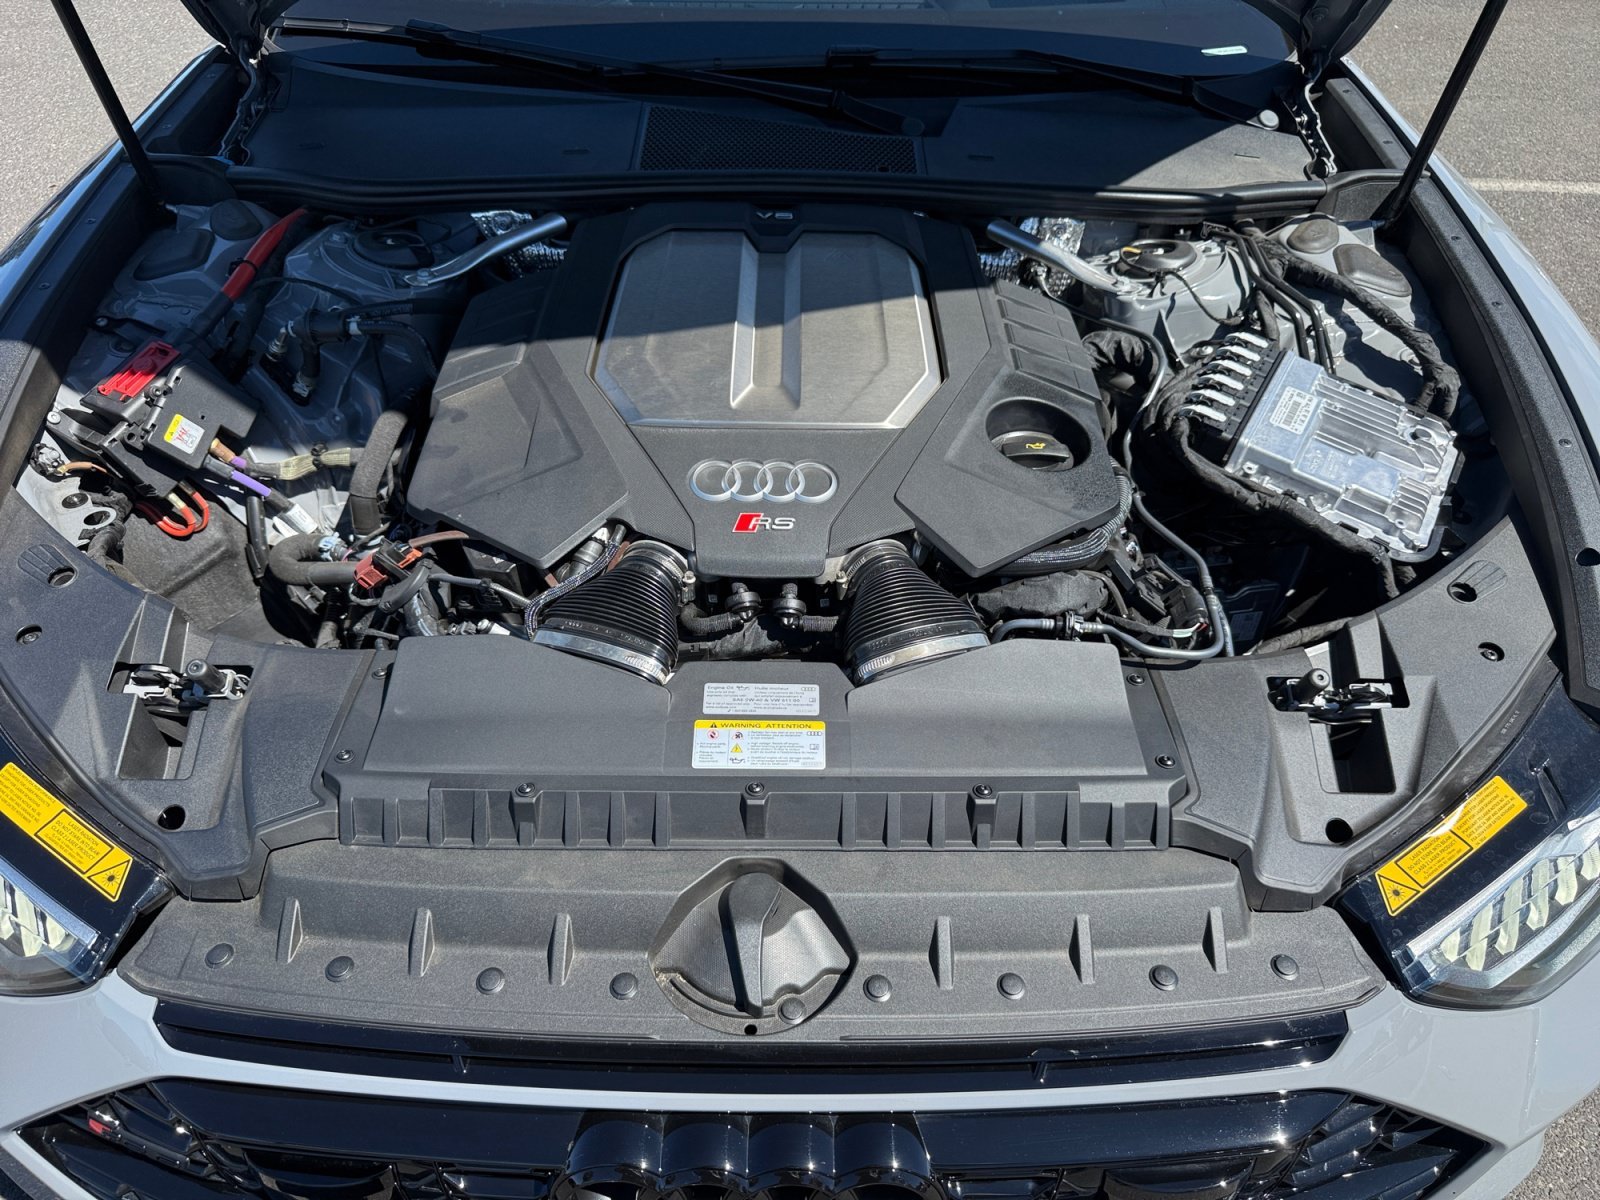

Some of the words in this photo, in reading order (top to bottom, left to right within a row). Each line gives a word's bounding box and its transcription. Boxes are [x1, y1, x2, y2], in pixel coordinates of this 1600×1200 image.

[746, 515, 796, 531] RS
[68, 821, 80, 832] LASER
[1409, 849, 1422, 860] LASER
